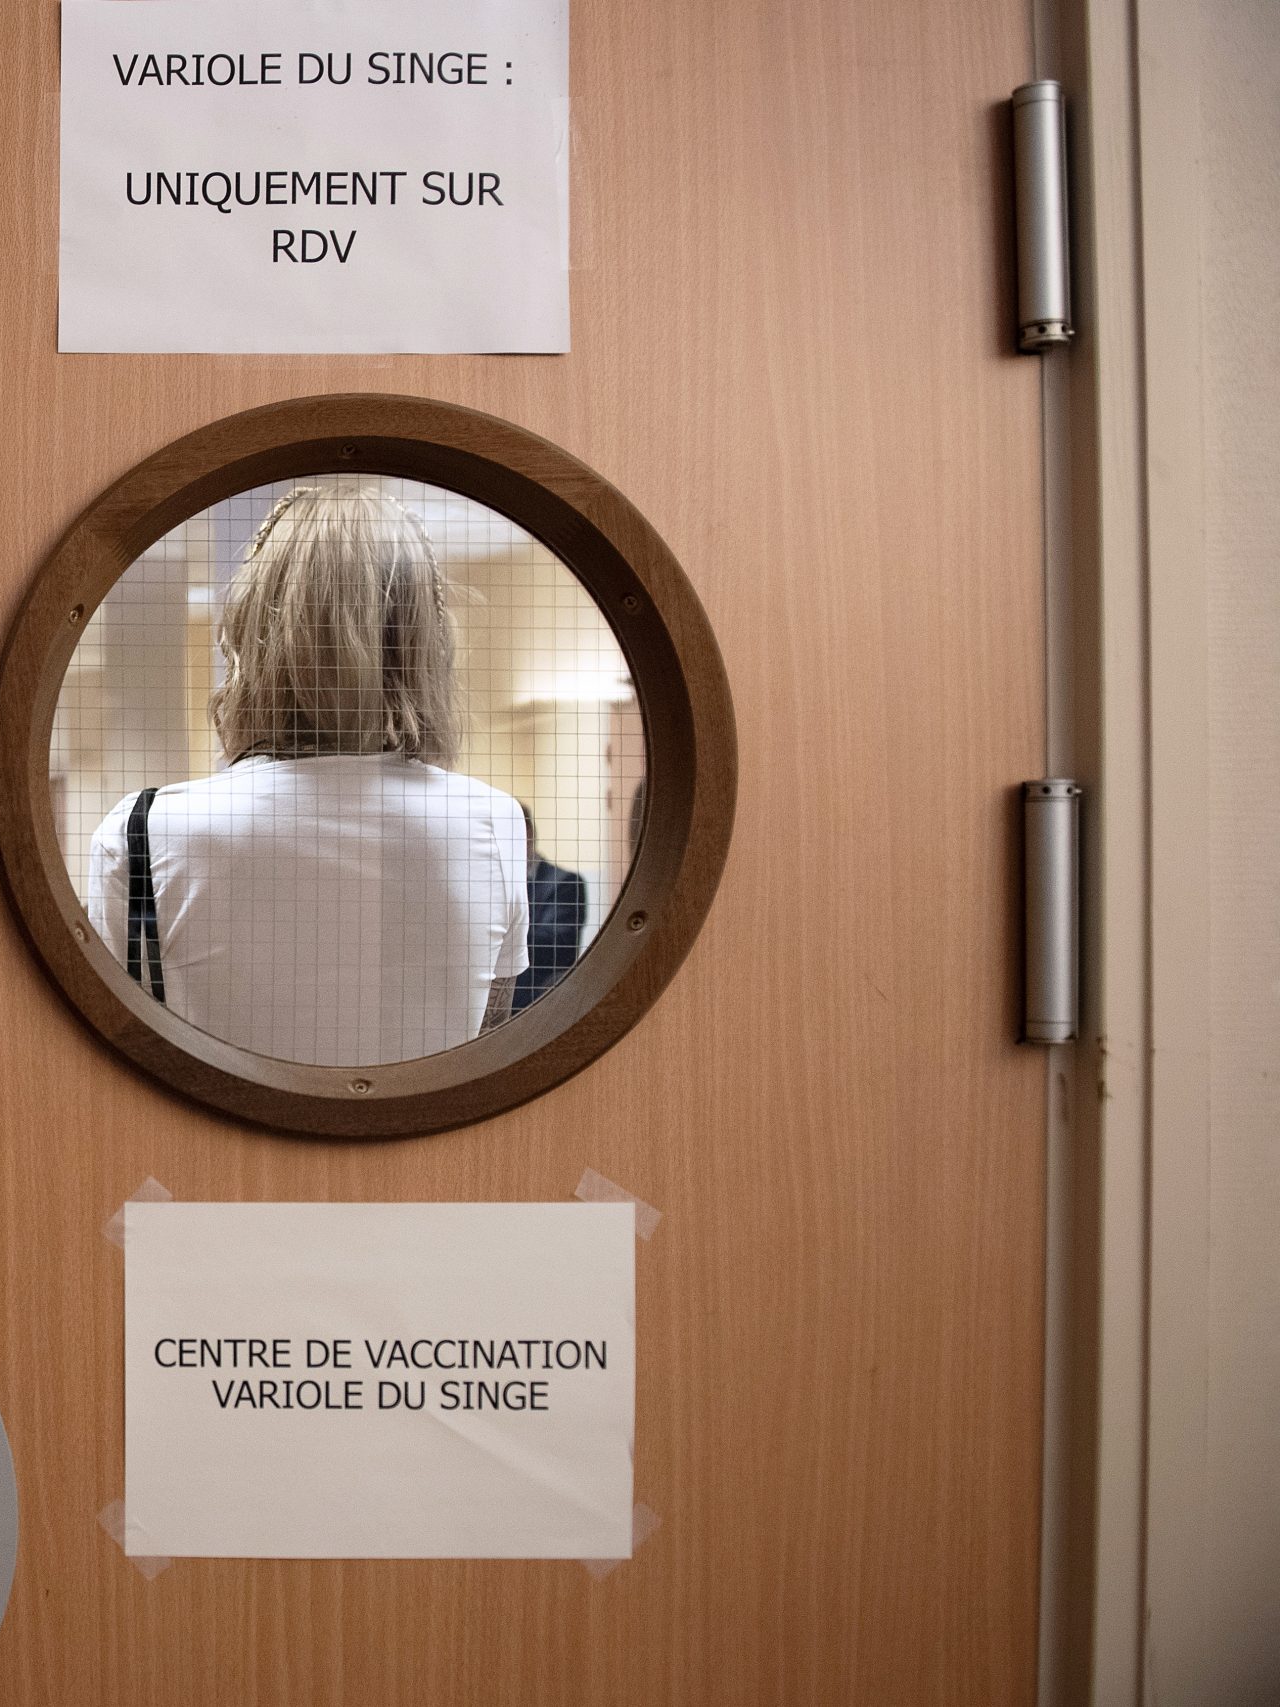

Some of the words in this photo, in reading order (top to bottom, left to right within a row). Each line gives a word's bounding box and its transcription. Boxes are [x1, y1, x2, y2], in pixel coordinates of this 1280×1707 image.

[112, 53, 282, 86] VARIOLE
[298, 52, 353, 85] DU
[367, 51, 488, 85] SINGE
[125, 171, 408, 214] UNIQUEMENT
[422, 170, 505, 206] SUR
[272, 229, 357, 264] RDV
[154, 1338, 291, 1368] CENTRE
[306, 1339, 352, 1369] DE
[364, 1339, 608, 1370] VACCINATION
[211, 1379, 363, 1410] VARIOLE
[378, 1380, 426, 1411] DU
[440, 1380, 549, 1411] SINGE
